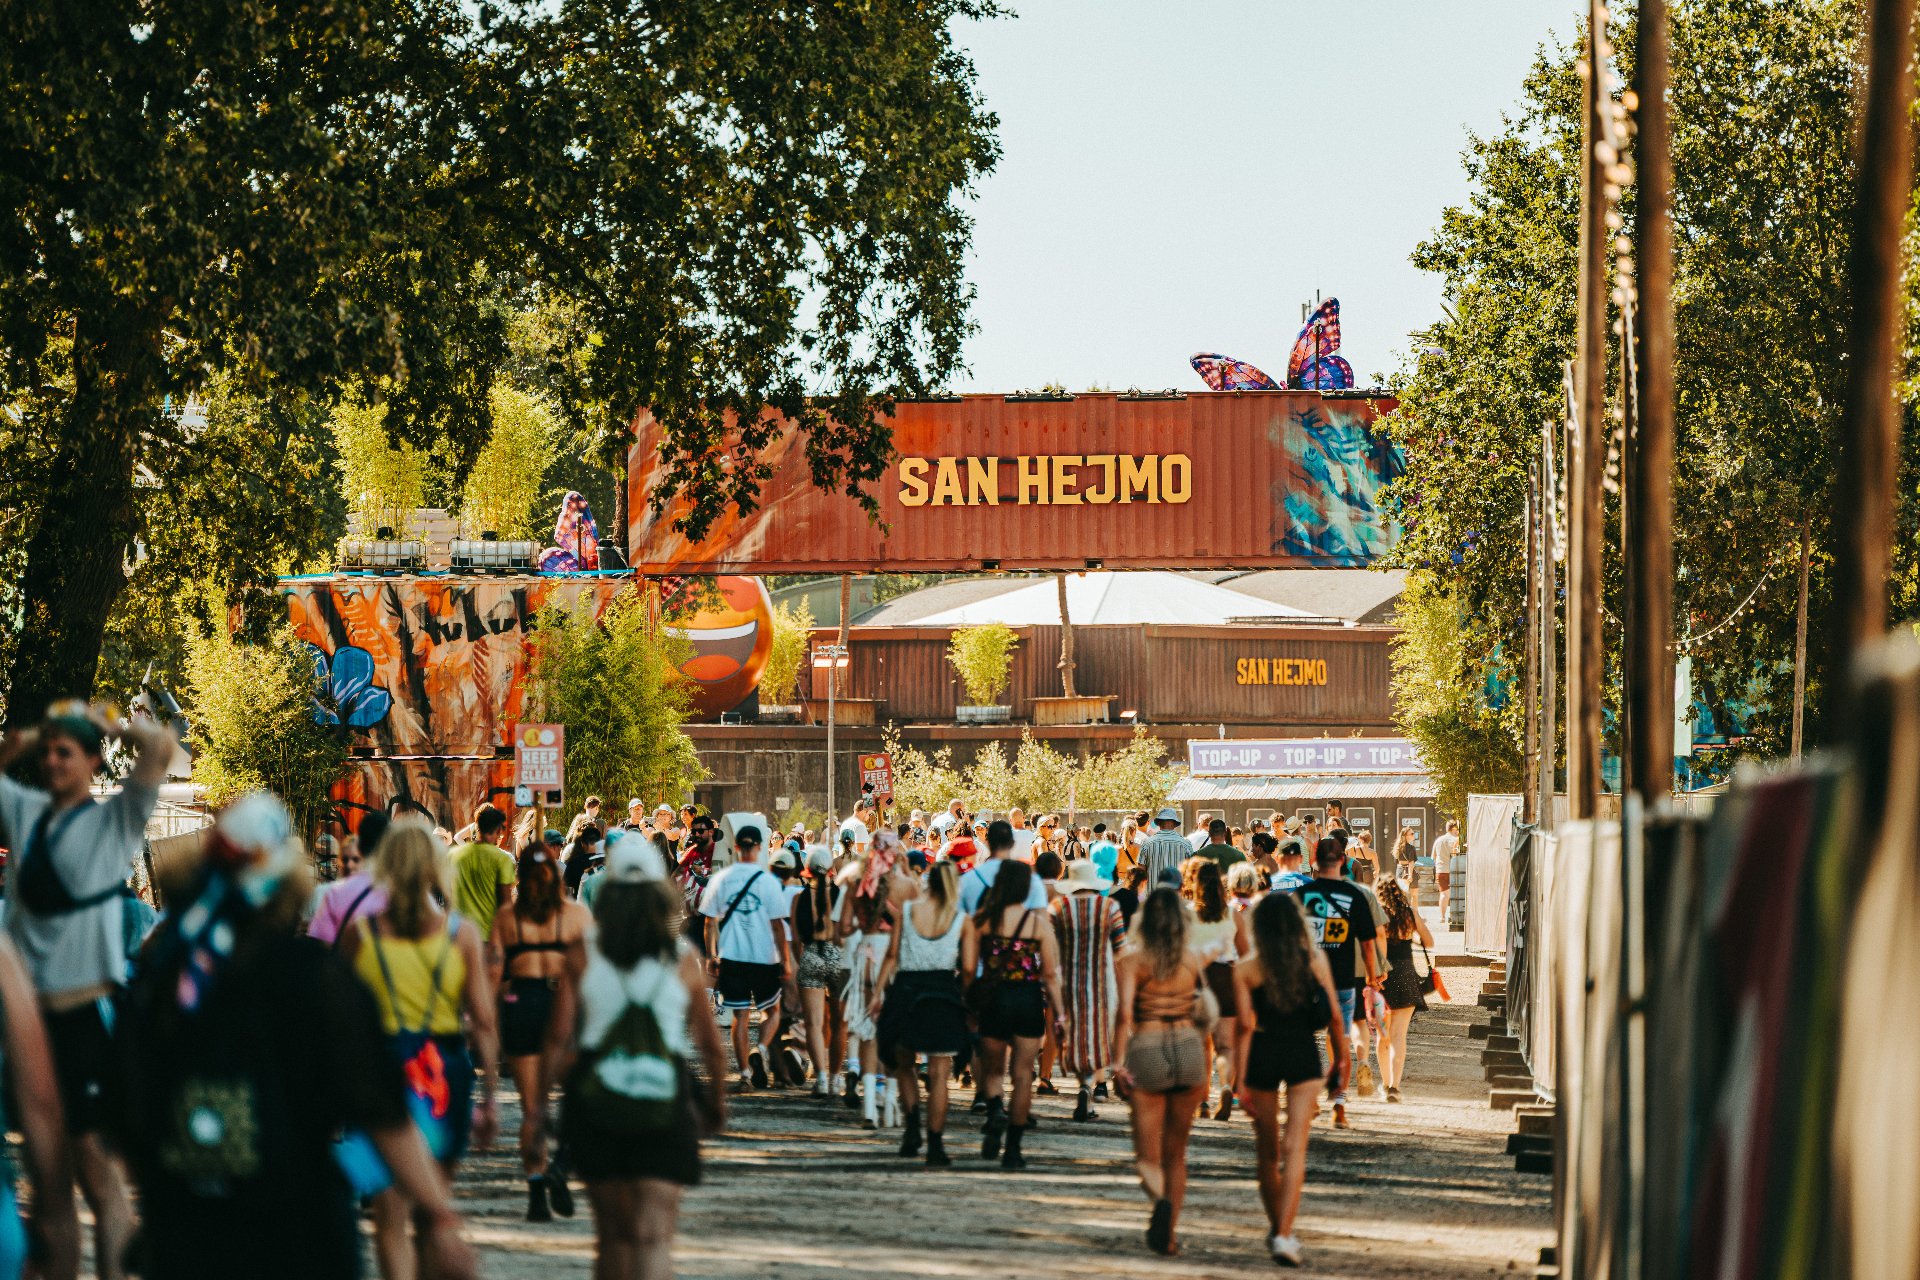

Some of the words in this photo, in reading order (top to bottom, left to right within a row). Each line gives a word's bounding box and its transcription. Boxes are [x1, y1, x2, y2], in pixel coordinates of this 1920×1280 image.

[899, 457, 999, 506] SAN
[1017, 454, 1192, 505] HEJMO
[1237, 658, 1269, 685] SAN
[1273, 658, 1327, 685] HEJMO
[522, 751, 558, 764] KEEP
[1199, 749, 1262, 767] TOP-UP
[1284, 748, 1346, 766] TOP-UP
[521, 770, 557, 781] CLEAN
[864, 771, 888, 781] KEEP
